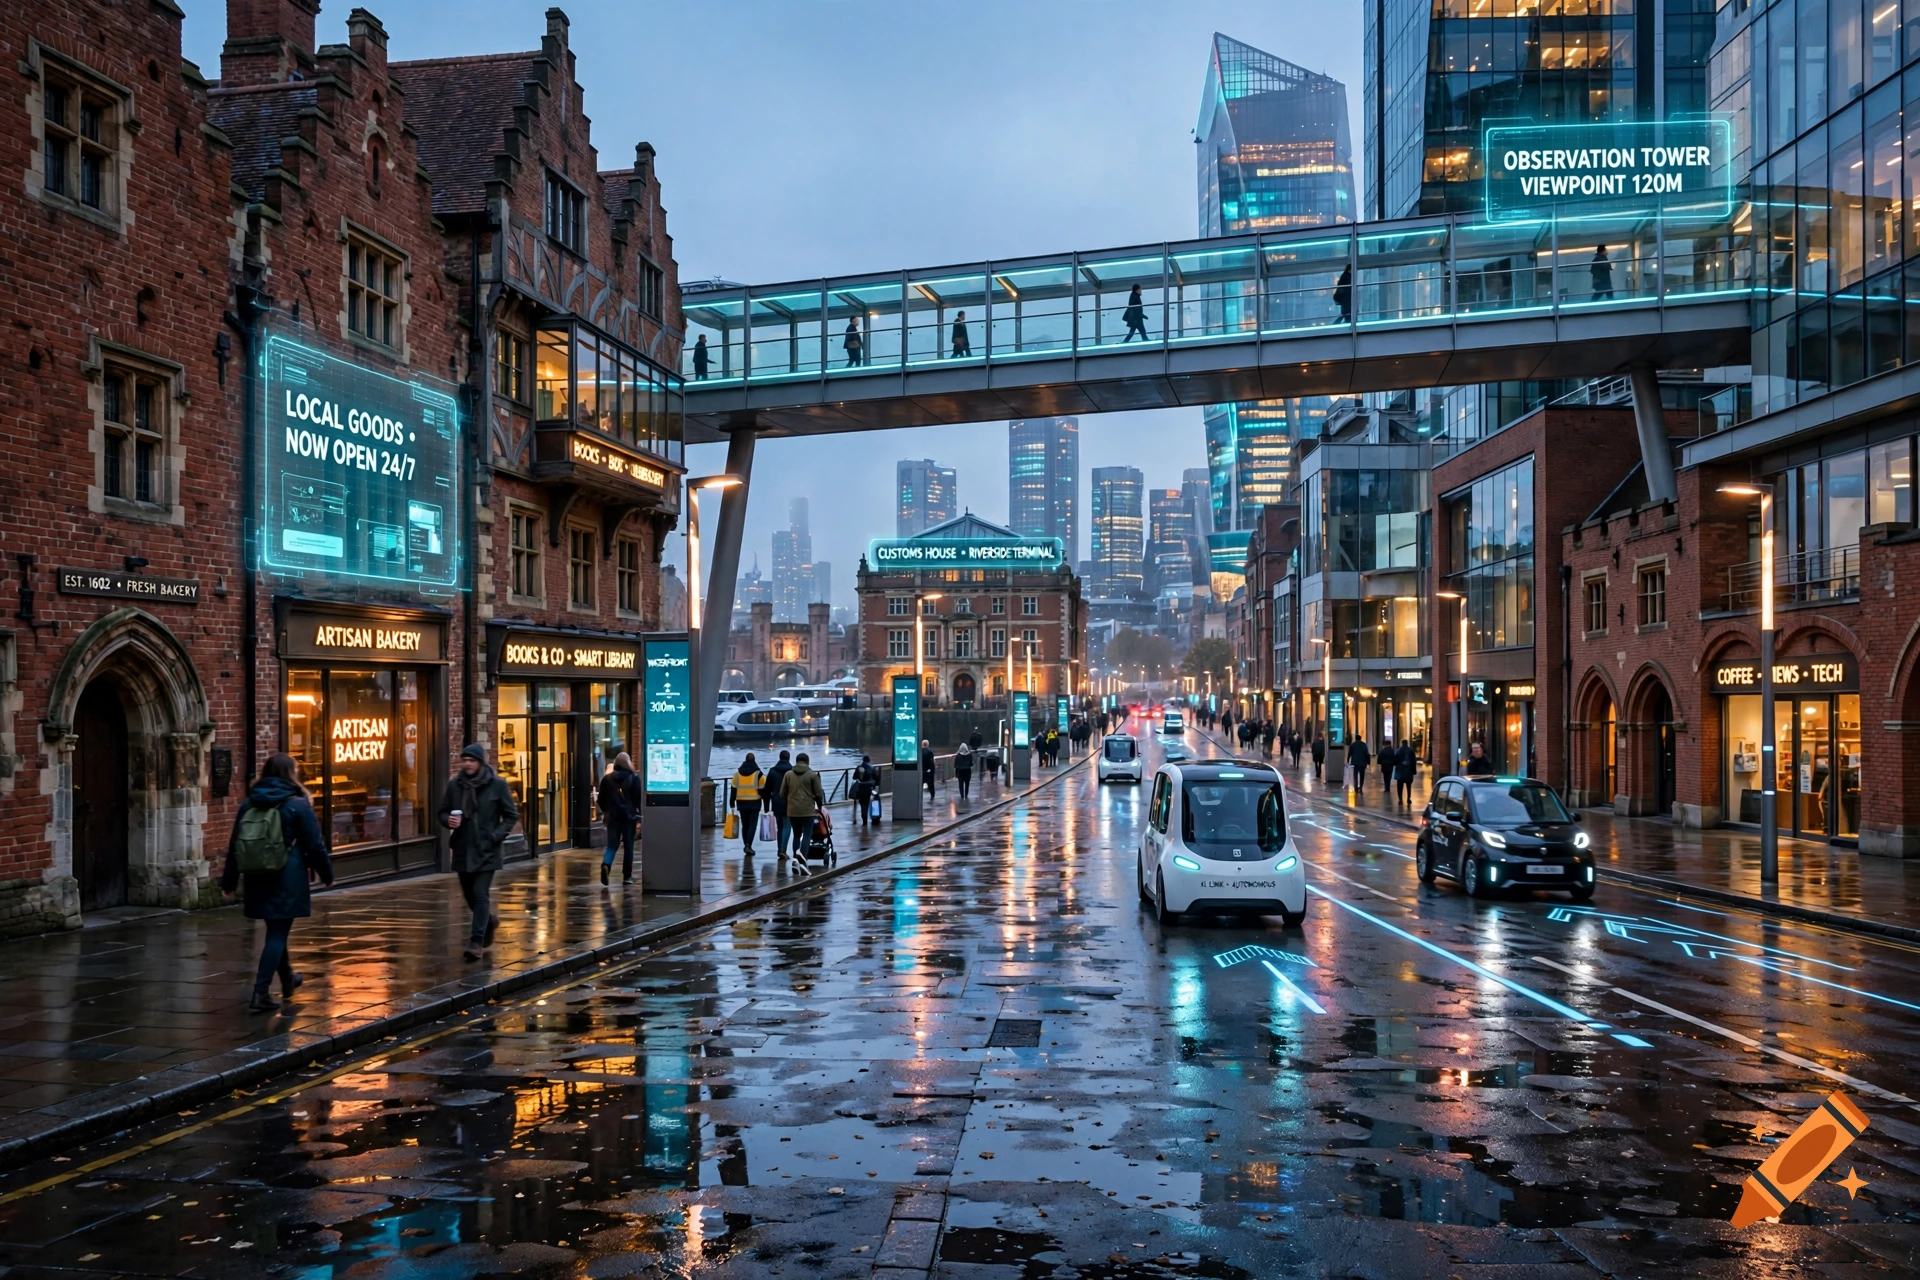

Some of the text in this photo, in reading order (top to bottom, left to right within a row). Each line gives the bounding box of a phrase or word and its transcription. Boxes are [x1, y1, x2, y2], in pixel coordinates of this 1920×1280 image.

[1503, 146, 1711, 171] OBSERVATION TOWER
[1520, 172, 1683, 196] VIEWPOINT 120M
[286, 389, 404, 446] LOCAL GOODS
[286, 426, 416, 481] NOW OPEN 24/7
[878, 547, 923, 560] CUSTOMS
[925, 547, 957, 560] HOUSE
[64, 575, 85, 588] EST.
[126, 579, 157, 594] FRESH
[160, 583, 197, 598] BAKERY
[315, 625, 421, 651] ARTISAN BAKERY
[506, 644, 636, 669] BOOKS & CO SMART LIBRARY
[1717, 666, 1754, 685] COFFEE
[1811, 663, 1843, 683] TECH
[332, 717, 389, 739] ARTISAN
[335, 740, 387, 762] BAKERY
